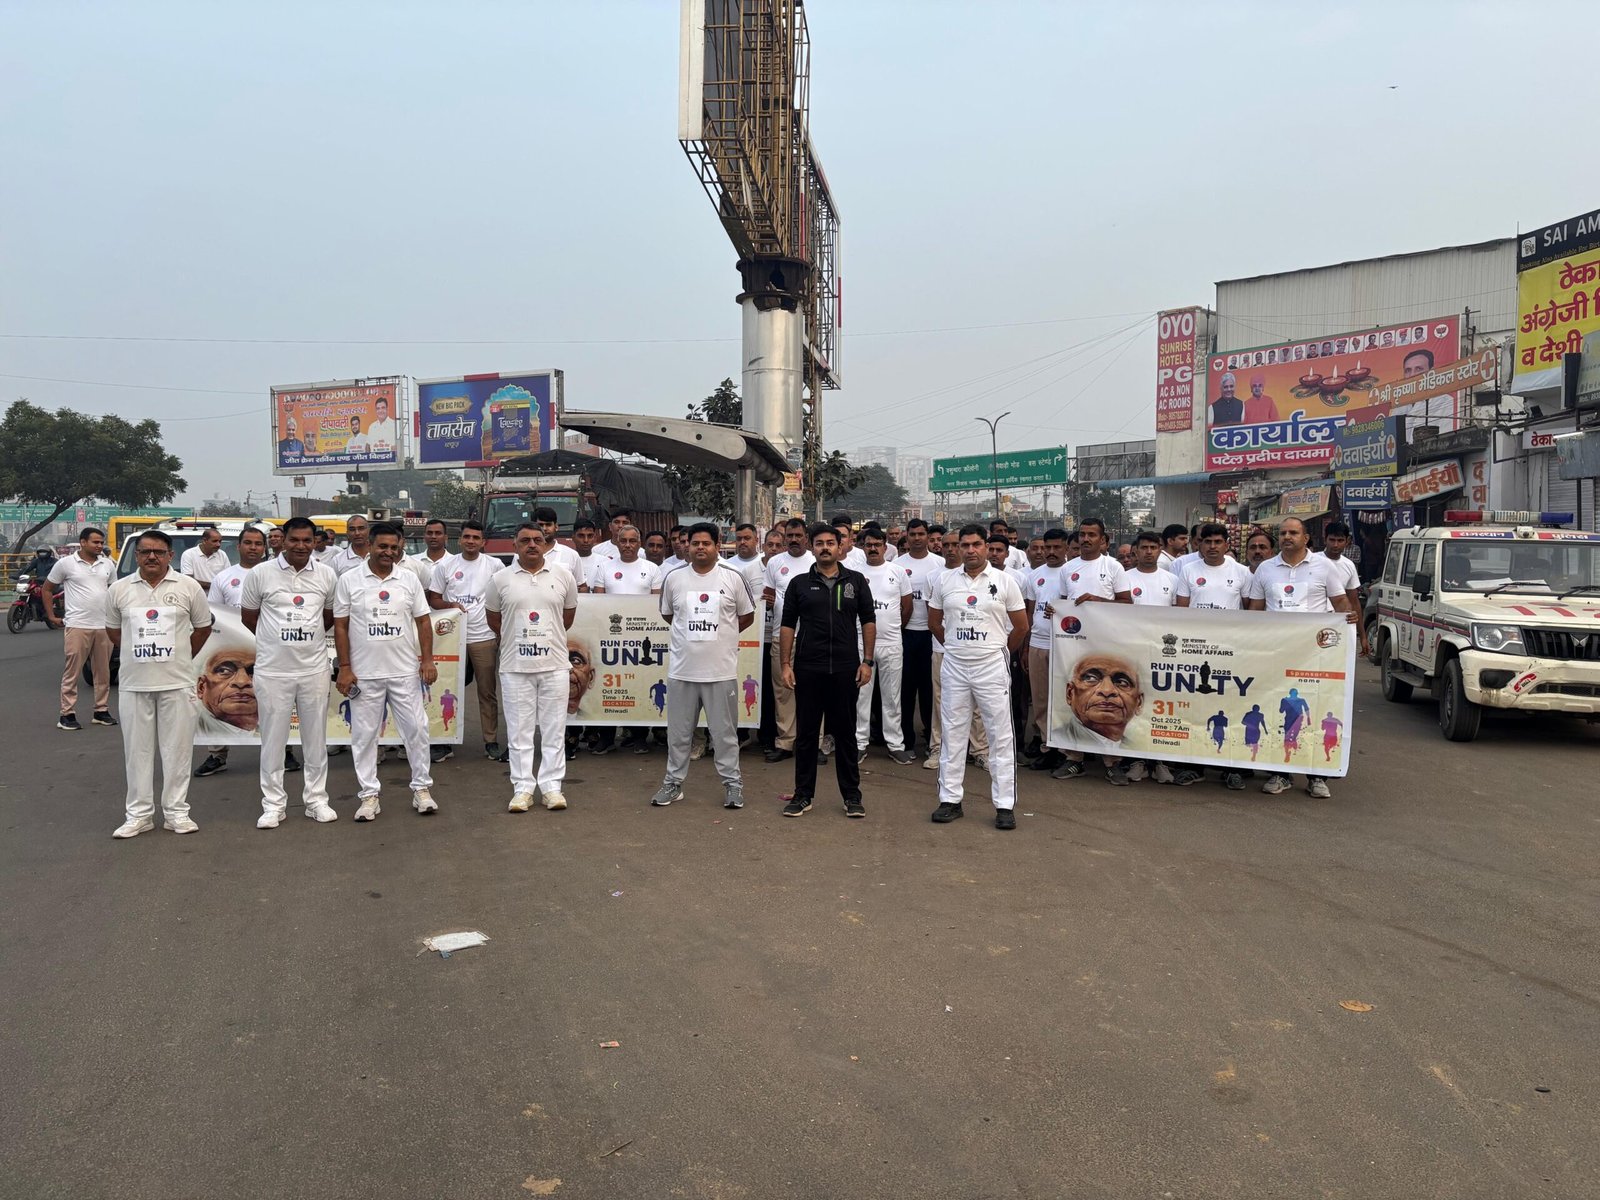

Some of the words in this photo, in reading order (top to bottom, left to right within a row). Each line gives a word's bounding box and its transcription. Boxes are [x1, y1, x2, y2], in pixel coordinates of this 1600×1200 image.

[1544, 224, 1568, 246] SAI
[1520, 291, 1589, 334] अंग्रेजी
[1160, 313, 1194, 339] OYO
[1160, 340, 1192, 354] SUNRISE
[1160, 354, 1184, 367] HOTEL
[1186, 352, 1192, 363] &
[1522, 347, 1536, 366] व
[1159, 366, 1193, 384] PG
[1380, 384, 1391, 402] श्री
[1393, 382, 1416, 404] कृष्णा
[1418, 370, 1455, 391] मेडिकल
[1457, 359, 1480, 380] स्टोर
[1160, 386, 1168, 398] AC
[1170, 386, 1175, 396] &
[1176, 384, 1190, 395] NON
[436, 402, 445, 410] NEW
[454, 400, 465, 408] PACK
[1158, 399, 1168, 410] AC
[1169, 397, 1191, 409] ROOMS
[427, 416, 476, 440] तानसेन
[1531, 431, 1552, 447] ठेका
[1343, 431, 1386, 465] दवाईयाँ
[1212, 452, 1244, 465] पटेल
[1246, 450, 1281, 464] प्रदीप
[1284, 448, 1331, 460] दायमा
[1346, 480, 1388, 498] दवाईयाँ
[369, 626, 401, 636] UNITY
[689, 623, 718, 632] UNITY
[957, 631, 988, 640] UNITY
[281, 631, 314, 641] UNITY
[134, 647, 173, 657] UNITY
[519, 647, 550, 656] UNITY
[602, 648, 669, 666] UNIT
[1151, 663, 1174, 671] RUN
[1177, 664, 1200, 672] FOR
[1152, 672, 1255, 696] UNITY
